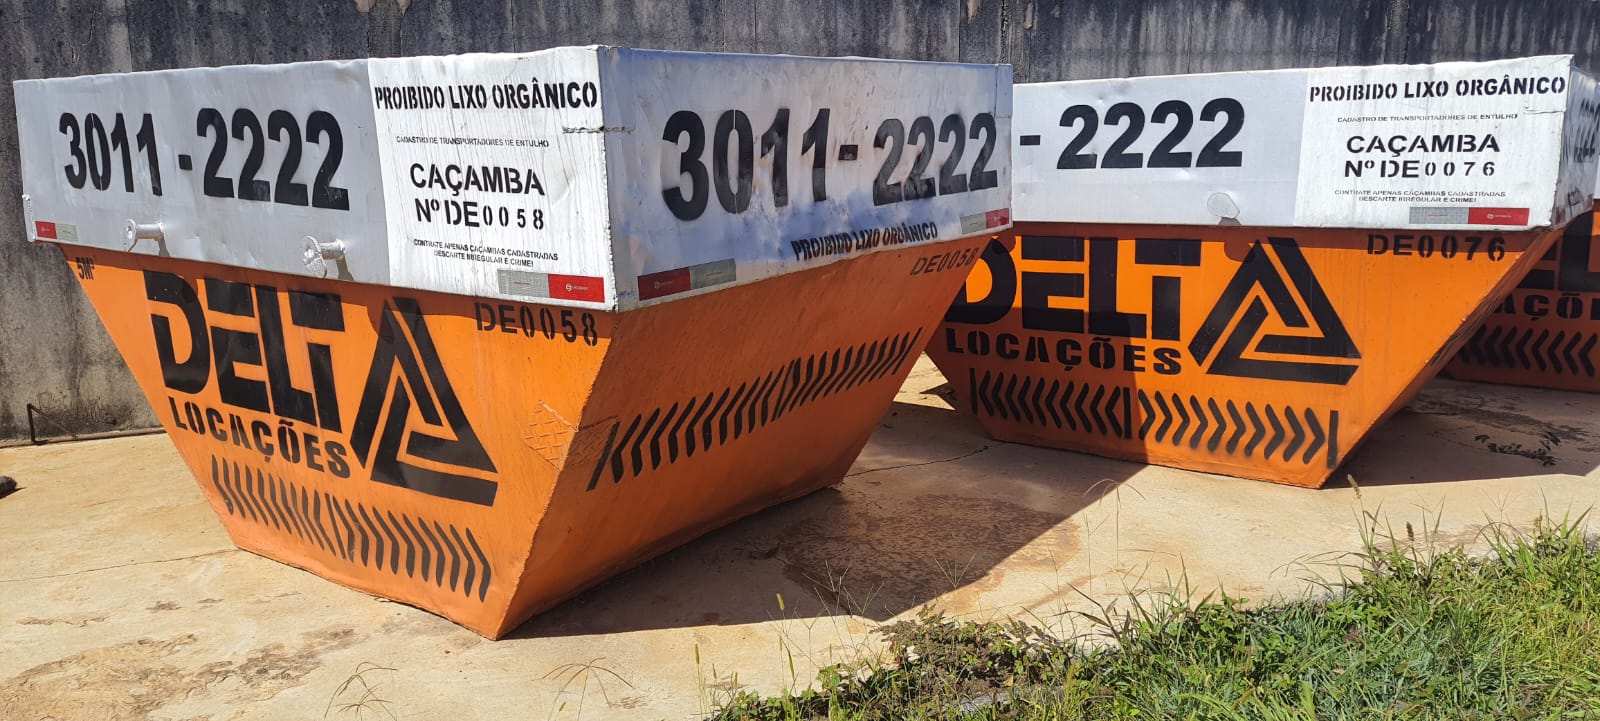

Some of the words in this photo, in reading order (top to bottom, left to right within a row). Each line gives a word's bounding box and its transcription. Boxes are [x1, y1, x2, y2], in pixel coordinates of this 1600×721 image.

[374, 86, 444, 110] PROIBIDO
[448, 84, 487, 109] LIXO
[491, 77, 598, 110] ORGÂNICO
[1309, 83, 1398, 102] PROIBIDO
[1404, 80, 1449, 98] LIXO
[1455, 75, 1566, 97] ORGÂNICO
[516, 139, 550, 148] ENTULHO
[1346, 134, 1501, 157] CAÇAMBA
[409, 162, 546, 197] CAÇAMBA
[1344, 160, 1375, 178] Nº
[415, 198, 440, 223] Nº
[790, 232, 854, 261] PROIBIDO
[855, 229, 881, 249] LIXO
[883, 221, 938, 245] ORGÂNICO
[1367, 233, 1506, 262] DE0076
[910, 247, 980, 276] DE0058
[474, 302, 598, 346] DE0058
[945, 327, 1183, 376] LOCAÇÕES
[167, 396, 351, 480] LOCAÇÕES
